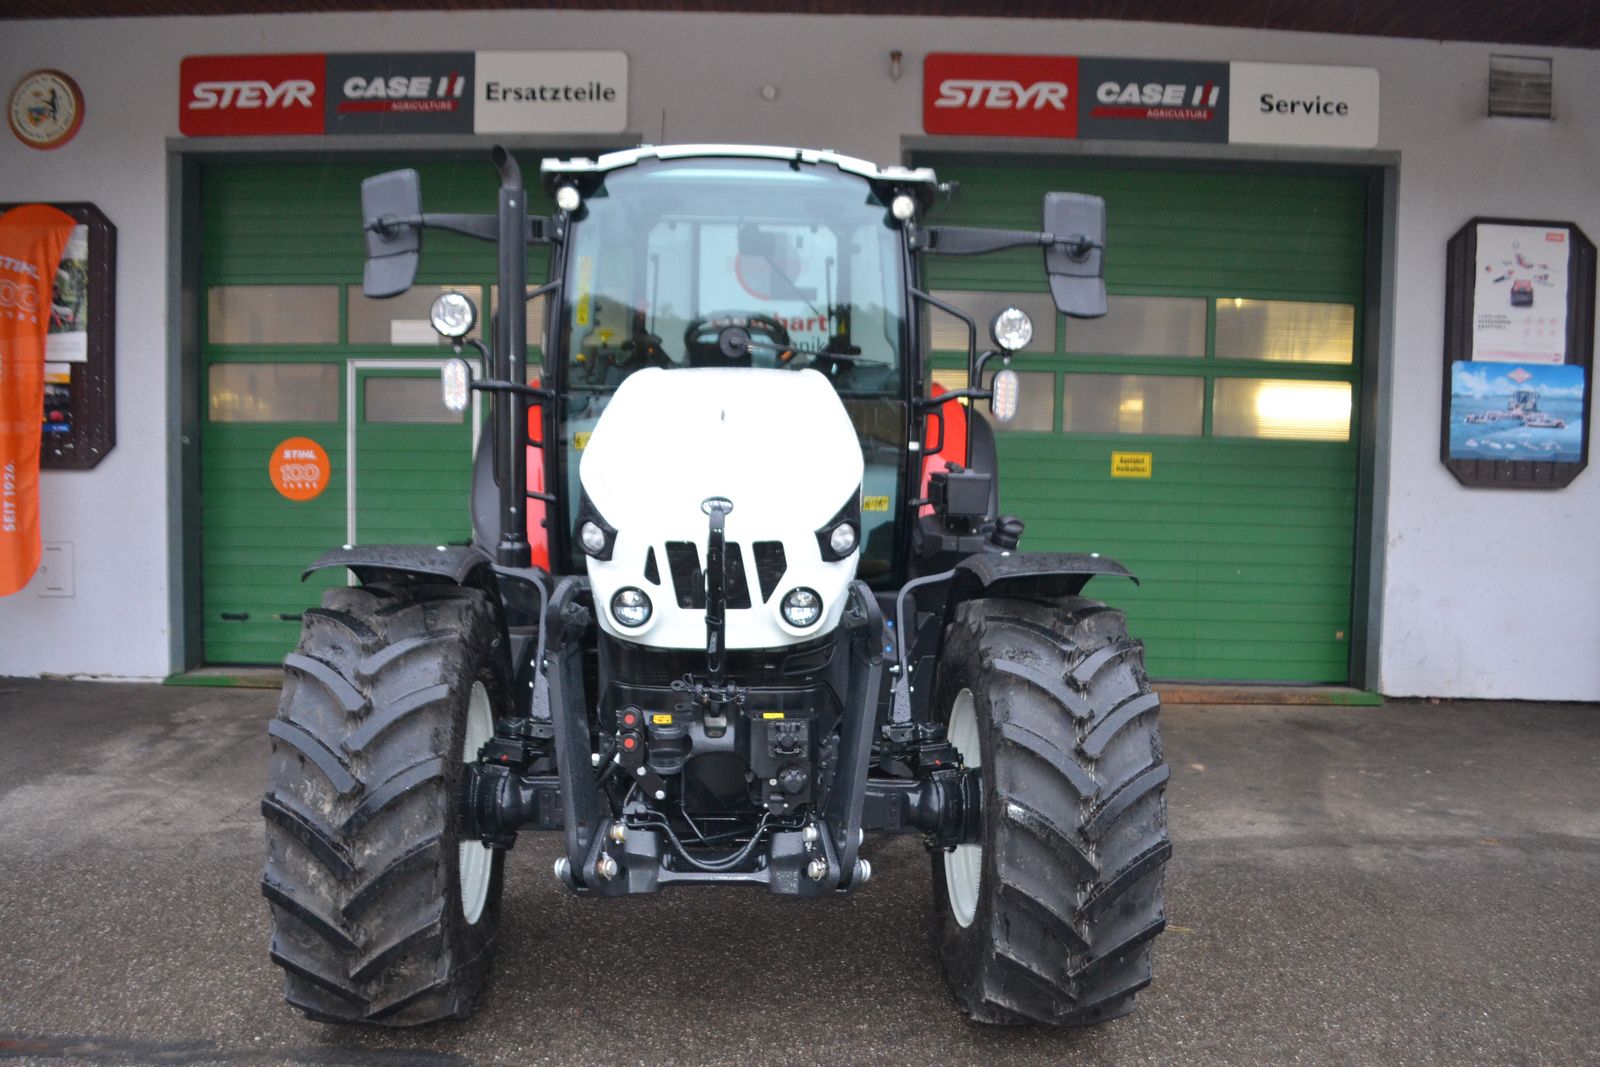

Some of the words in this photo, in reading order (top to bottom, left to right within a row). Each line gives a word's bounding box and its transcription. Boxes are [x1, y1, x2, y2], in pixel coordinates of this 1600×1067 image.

[188, 80, 316, 110] STEYR
[344, 76, 432, 98] CASE
[485, 82, 616, 101] Ersatzteile
[934, 79, 1069, 111] STEYR
[1096, 81, 1187, 106] CASE
[390, 101, 453, 112] AGRICULTURE
[1146, 108, 1209, 120] AGRICULTURE
[1259, 93, 1349, 116] Service
[283, 449, 318, 460] STIHL
[280, 463, 321, 482] 100
[3, 500, 17, 533] SEIT
